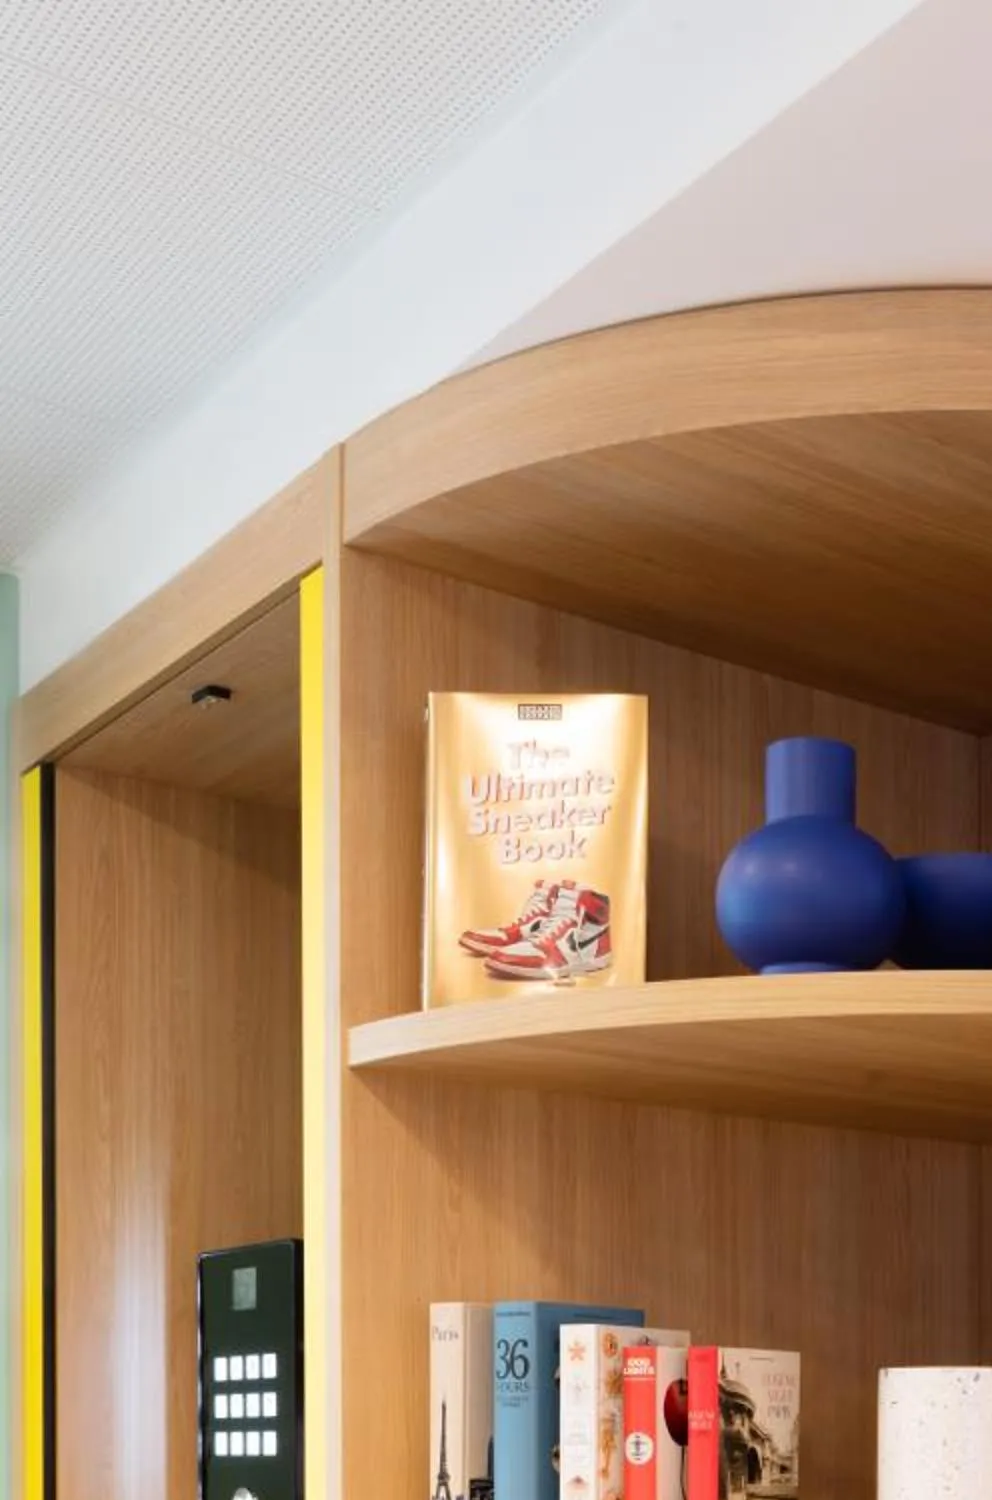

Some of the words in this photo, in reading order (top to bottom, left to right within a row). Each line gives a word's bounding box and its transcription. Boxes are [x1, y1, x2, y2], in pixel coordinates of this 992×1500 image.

[463, 769, 616, 806] Ultimate
[467, 801, 613, 836] Sneaker
[501, 832, 587, 864] Book
[496, 1338, 530, 1380] 36
